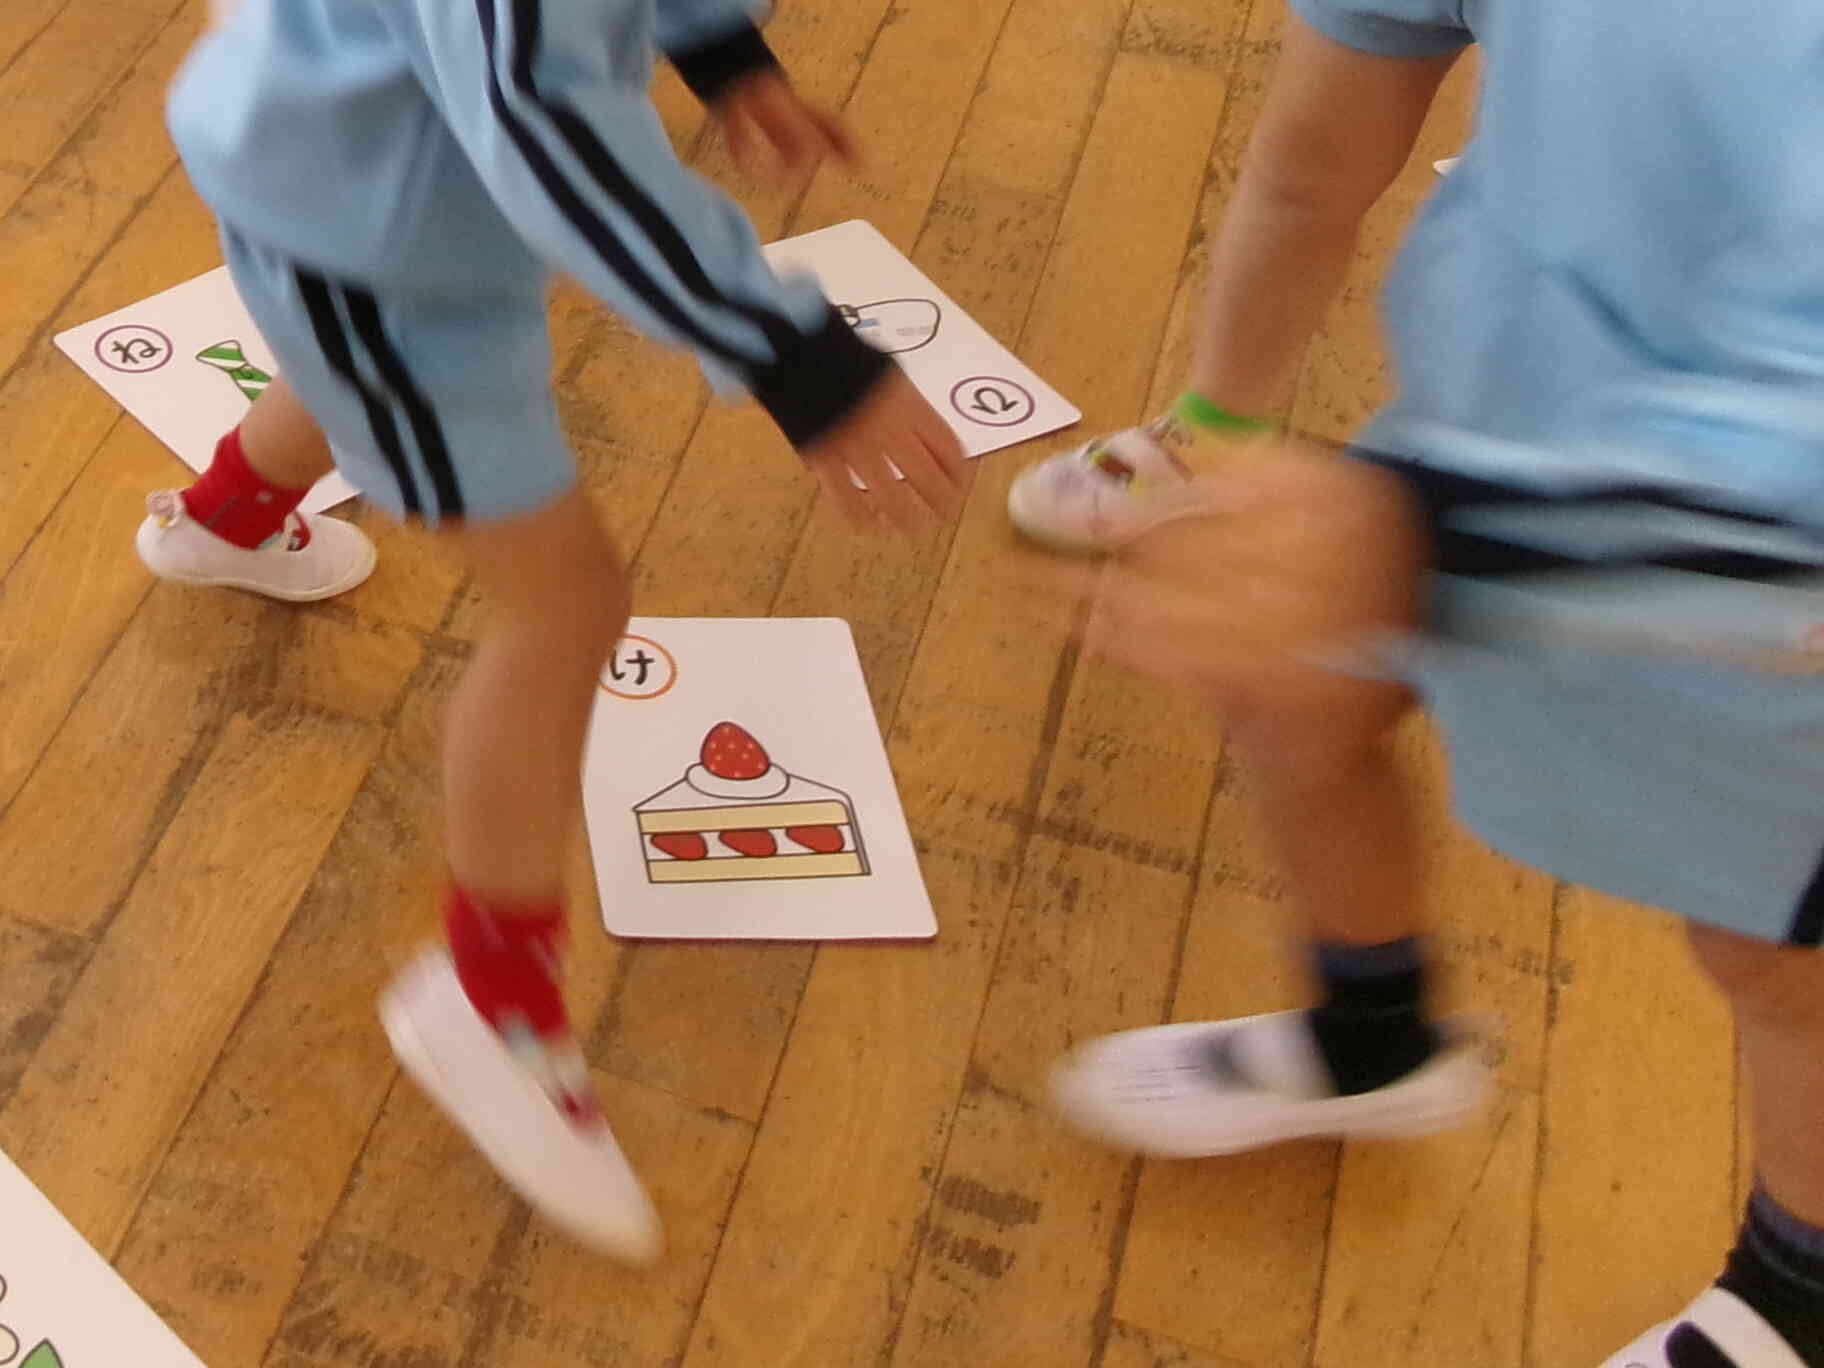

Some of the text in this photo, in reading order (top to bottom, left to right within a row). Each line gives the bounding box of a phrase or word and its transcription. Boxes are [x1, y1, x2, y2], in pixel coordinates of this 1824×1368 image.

[111, 338, 162, 365] ね
[970, 386, 1019, 415] ひ
[608, 648, 656, 686] け
